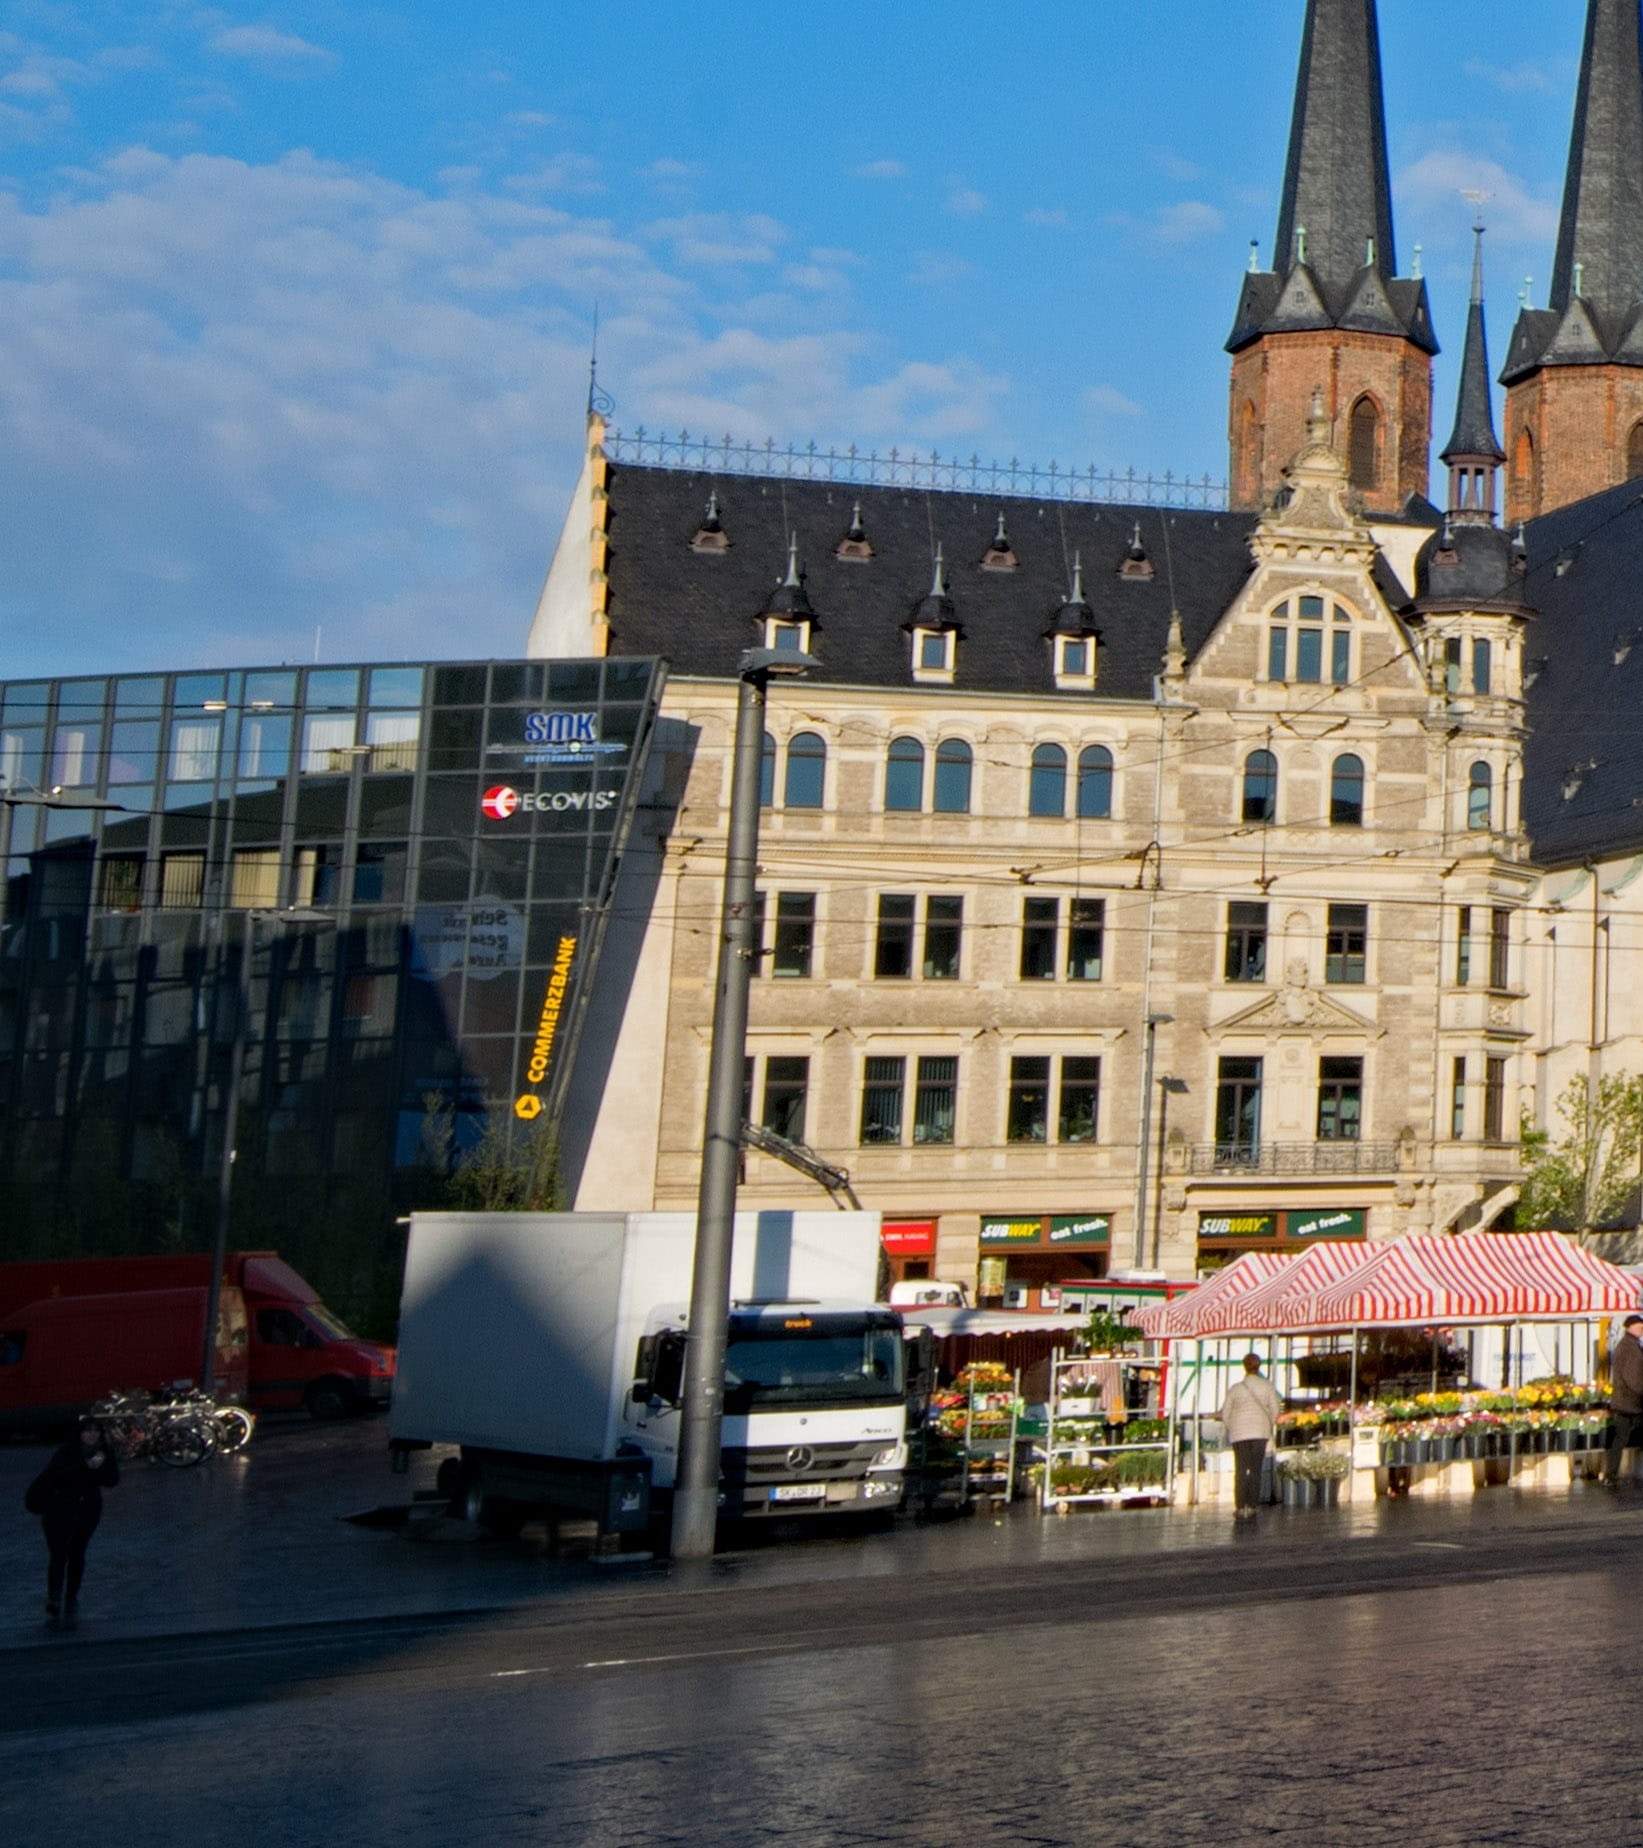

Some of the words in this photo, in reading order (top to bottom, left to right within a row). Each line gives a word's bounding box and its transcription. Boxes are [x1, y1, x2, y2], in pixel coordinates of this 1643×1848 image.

[525, 712, 597, 742] SMK
[521, 792, 613, 811] ECOVIS
[527, 936, 577, 1083] COMMERZBANK
[981, 1223, 1041, 1238] SUBWAY
[1050, 1226, 1071, 1241] eat
[1200, 1217, 1269, 1233] SUBWAY
[1298, 1221, 1318, 1235] eat
